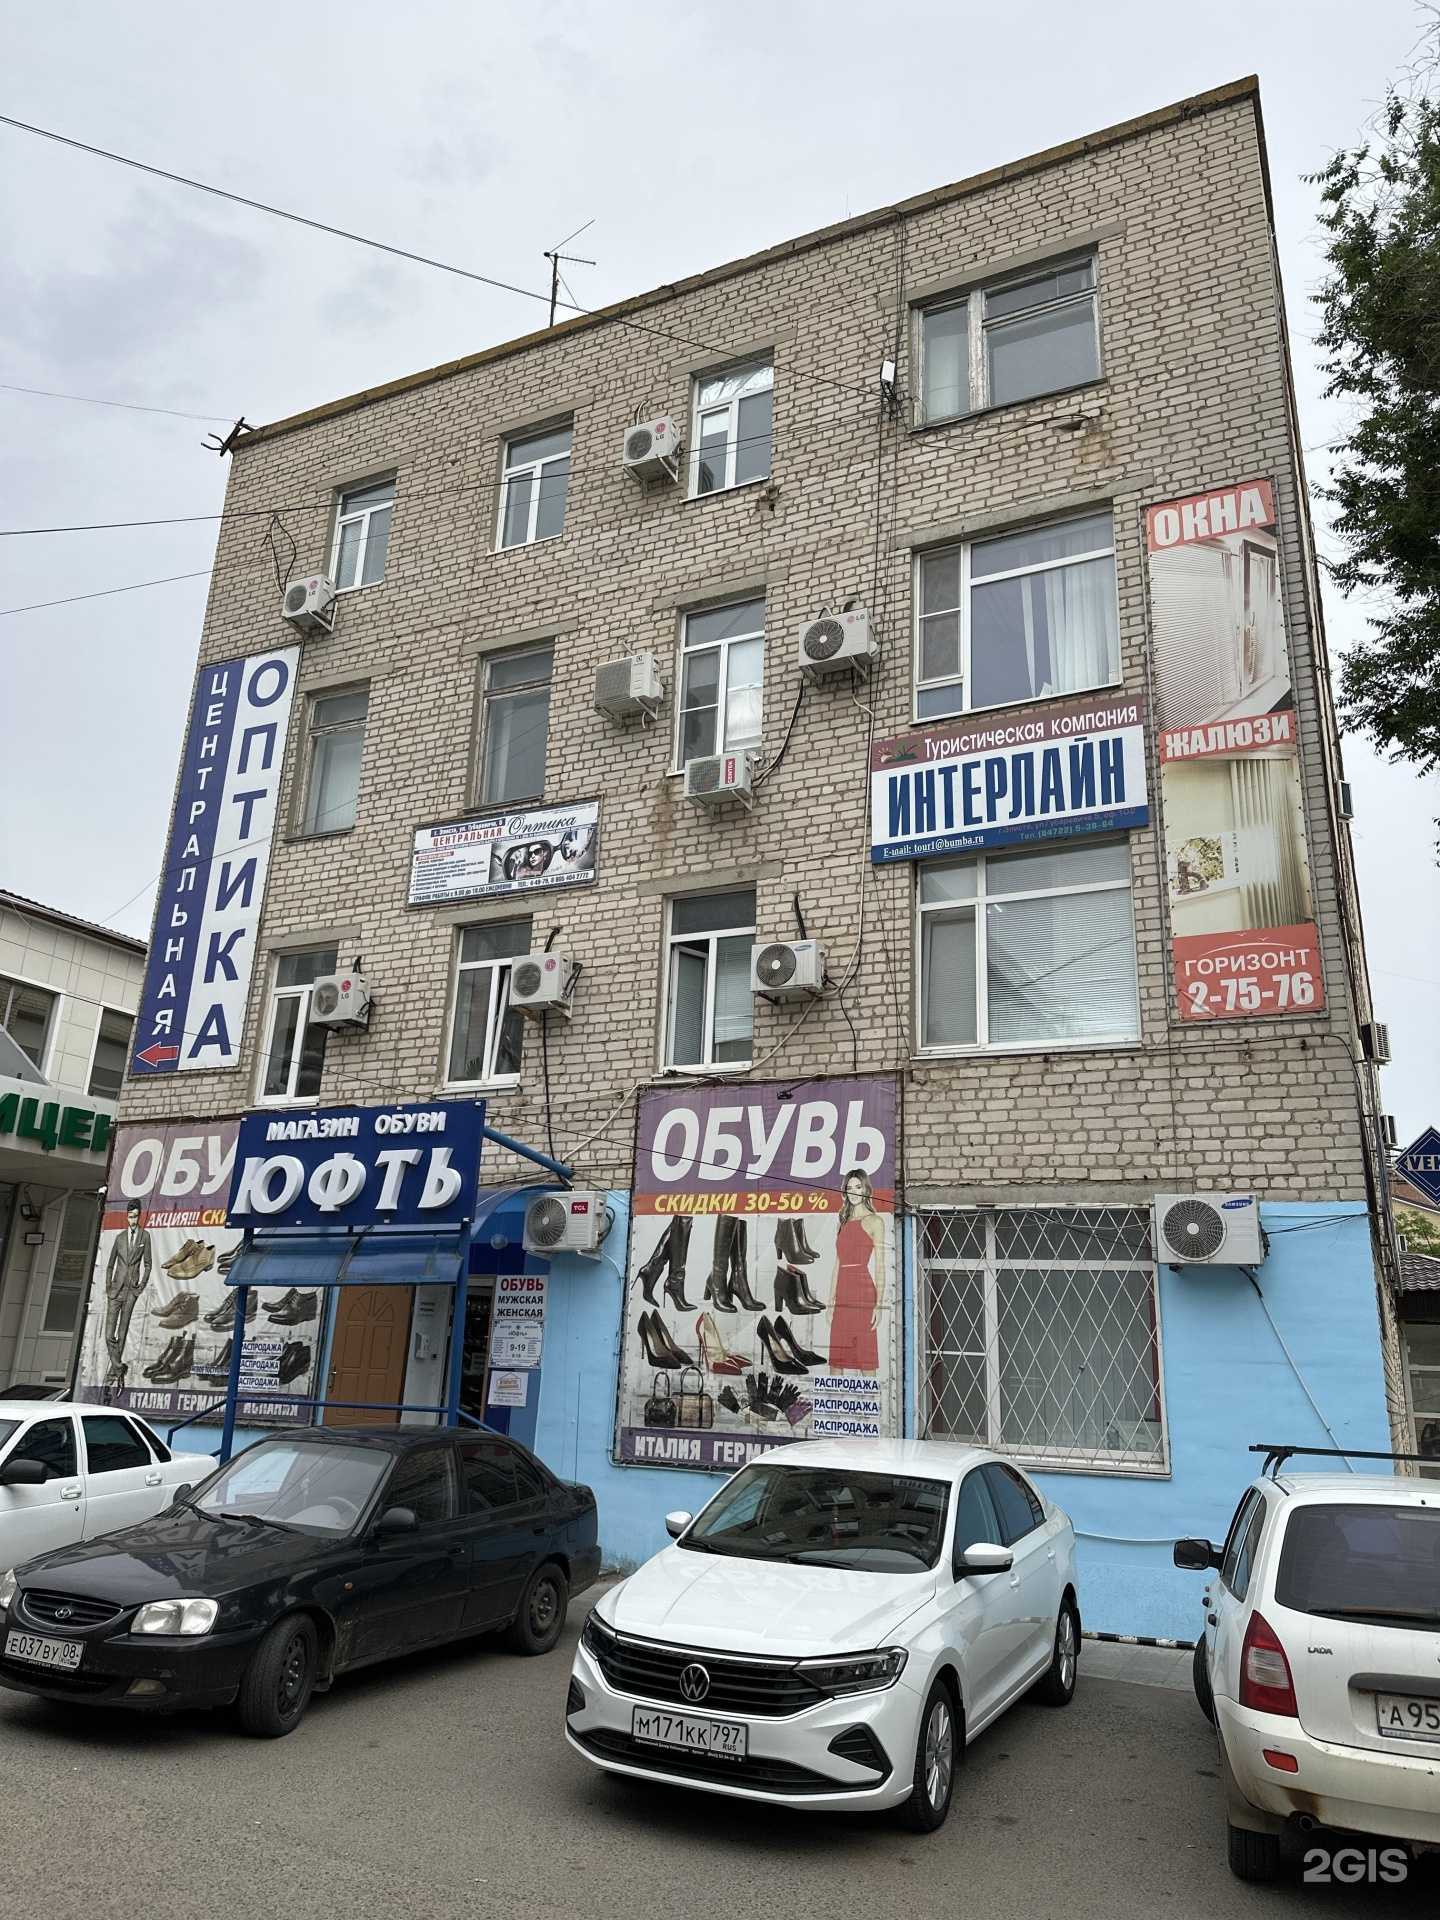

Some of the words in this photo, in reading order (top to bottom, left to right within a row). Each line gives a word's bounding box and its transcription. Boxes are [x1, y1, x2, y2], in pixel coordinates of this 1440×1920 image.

[1153, 487, 1267, 546] ОКНА
[924, 721, 1044, 761] Туристическая
[1051, 704, 1137, 737] компания
[1165, 714, 1290, 759] ЖАЛЮЗИ
[888, 737, 1126, 838] ИНТЕРЛАЙН
[507, 814, 576, 836] Оптика
[433, 828, 502, 847] ЦЕНТРАЛЬНАЯ
[883, 845, 912, 858] E-mail:
[914, 834, 984, 854] tour1@bumba.ru
[152, 672, 228, 1035] ЦЕНТРАЛЬНАЯ
[187, 659, 289, 1059] ОПТИКА
[1184, 949, 1310, 976] ГОРИЗОНТ
[1187, 972, 1315, 1014] 2-75-76
[265, 1115, 359, 1142] МАГАЗИН
[374, 1111, 446, 1135] ОБУВИ
[651, 1101, 886, 1182] ОБУВЬ
[120, 1135, 238, 1199] ОБУ
[230, 1147, 463, 1215] ЮФТЬ
[654, 1193, 737, 1215] СКИДКИ
[747, 1193, 803, 1212] 30-50
[808, 1192, 828, 1211] %
[147, 1211, 200, 1228] АКЦИЯ!!!
[501, 1278, 544, 1292] ОБУВЬ
[498, 1295, 543, 1305] МУЖСКАЯ
[497, 1308, 543, 1317] ЖЕНСКАЯ
[242, 1343, 282, 1353] АСПРОДАЖА
[240, 1359, 278, 1370] АСПРОДАЖА
[239, 1376, 278, 1387] АСПРОДАЖА
[814, 1378, 878, 1391] РАСПРОДАЖА
[129, 1392, 170, 1410] ИТАЛИЯ
[814, 1399, 878, 1412] РАСПРОДАЖА
[814, 1420, 878, 1434] РАСПРОДАЖА
[635, 1436, 701, 1460] ИТАЛИЯ
[63, 1643, 77, 1659] 08
[1308, 1647, 1333, 1655] LADA
[1390, 1702, 1440, 1729] А95
[712, 1724, 740, 1745] 797
[722, 1743, 737, 1752] RUS
